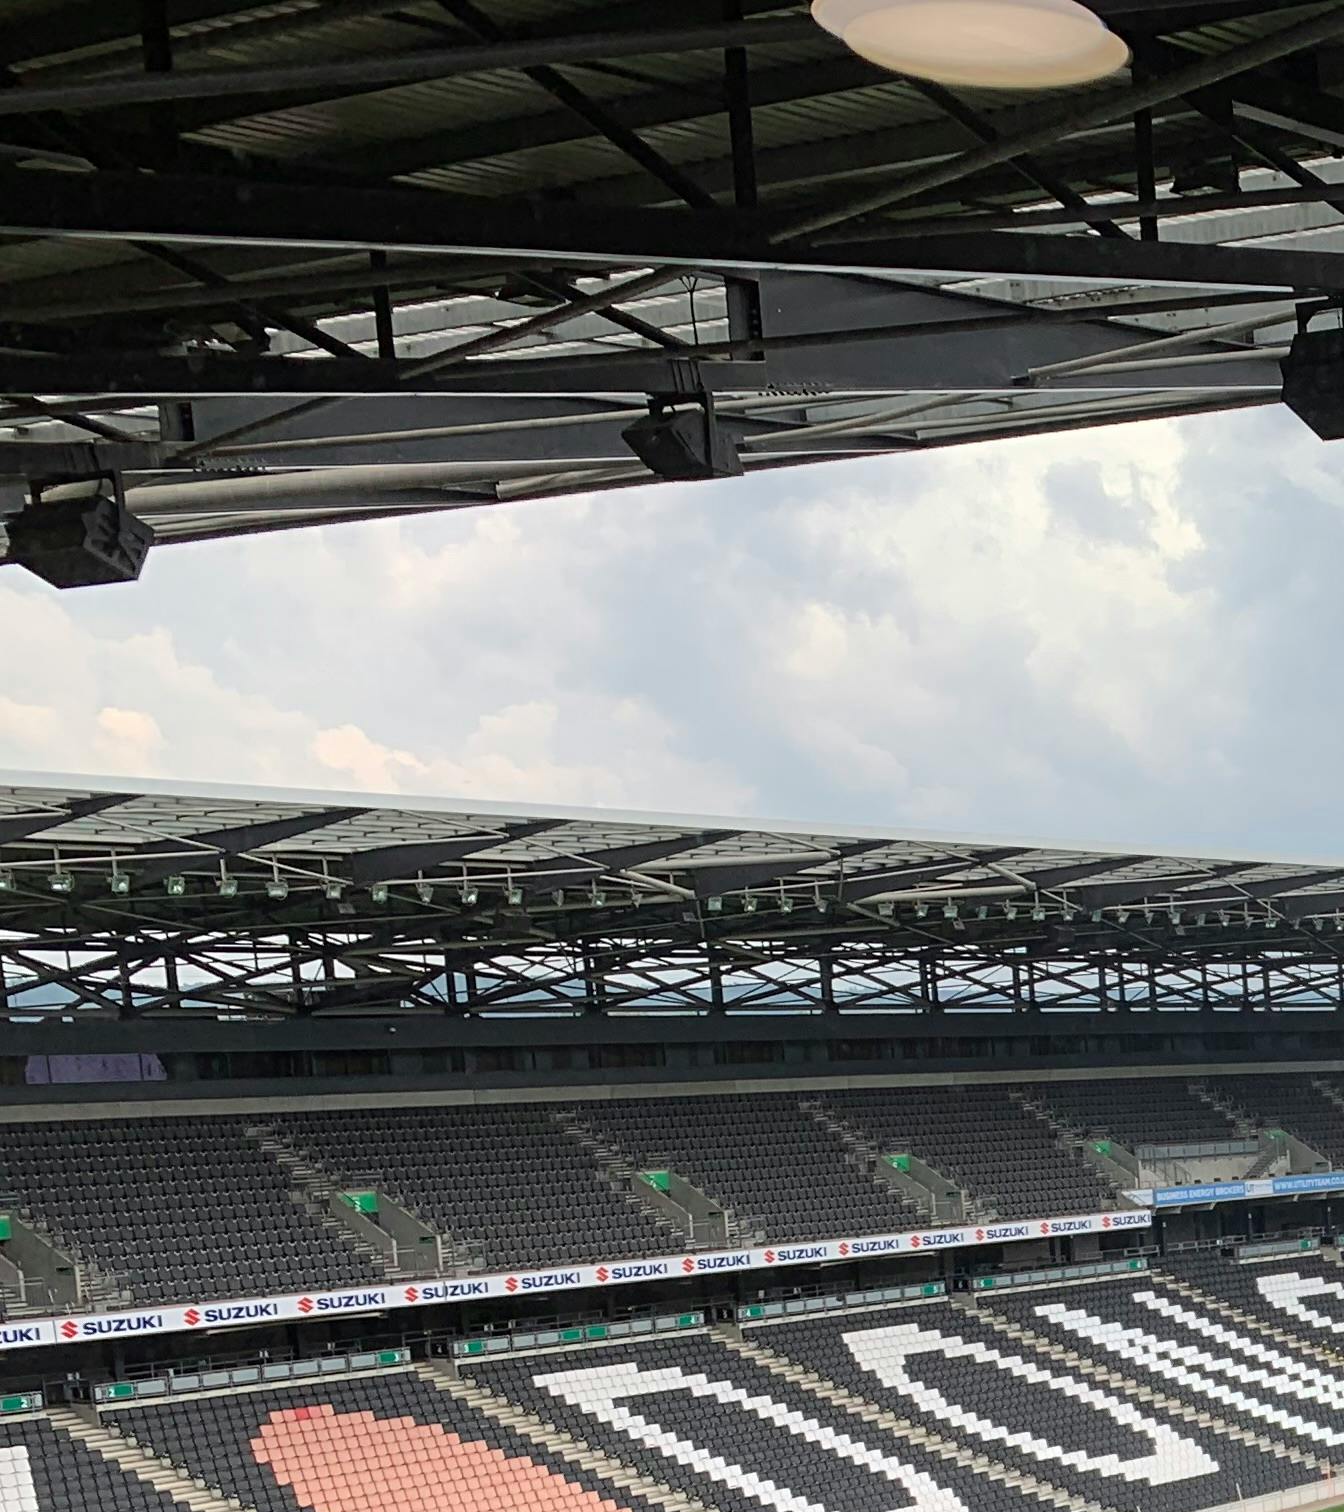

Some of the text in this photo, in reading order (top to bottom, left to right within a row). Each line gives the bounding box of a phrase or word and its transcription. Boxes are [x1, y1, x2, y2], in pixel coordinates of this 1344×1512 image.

[1051, 1220, 1091, 1233] SUZUKI
[1113, 1213, 1150, 1227] SUZUKI
[922, 1232, 964, 1246] SUZUKI
[986, 1226, 1028, 1240] SUZUKI
[778, 1246, 827, 1262] SUZUKI
[851, 1239, 899, 1254] SUZUKI
[697, 1254, 750, 1270] SUZUKI
[612, 1263, 668, 1280] SUZUKI
[521, 1272, 580, 1289] SUZUKI
[422, 1282, 488, 1300] SUZUKI
[316, 1292, 385, 1310] SUZUKI
[204, 1303, 278, 1324] SUZUKI
[83, 1315, 163, 1335] SUZUKI
[0, 1326, 41, 1344] UKI
